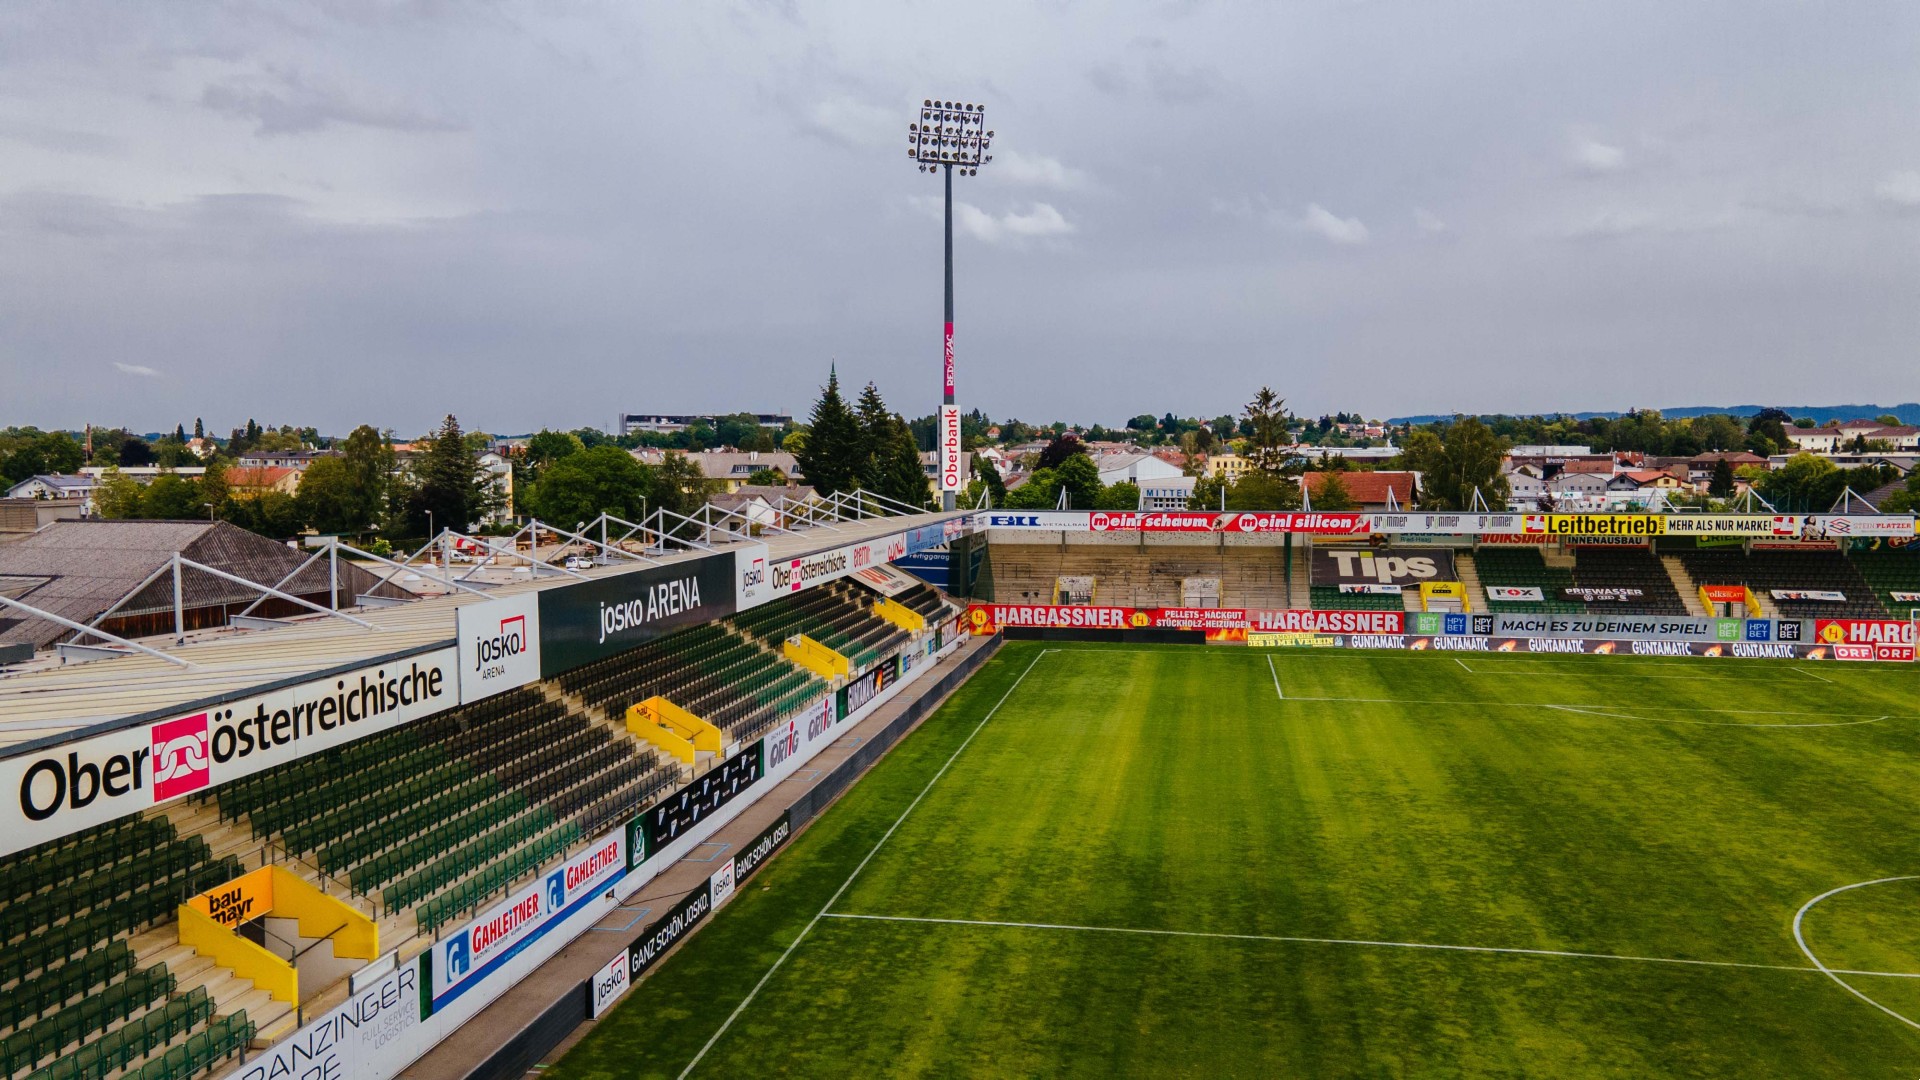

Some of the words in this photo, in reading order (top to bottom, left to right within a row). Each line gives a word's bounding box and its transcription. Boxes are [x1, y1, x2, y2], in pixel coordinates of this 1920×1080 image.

[945, 409, 958, 487] Oberbank
[1145, 514, 1207, 527] schaum
[1240, 514, 1292, 529] meinl
[1295, 514, 1351, 528] silicon
[1548, 515, 1657, 534] Leitbetrieb
[1669, 520, 1693, 530] MEHR
[1696, 520, 1713, 530] ALS
[1715, 520, 1734, 531] NUR
[1736, 520, 1772, 531] MARKE!
[772, 566, 792, 589] Ober
[800, 552, 846, 581] österreichische
[1328, 551, 1438, 583] Tips
[743, 569, 762, 592] josko
[1565, 588, 1643, 596] PRIEWASSER
[600, 599, 642, 644] josko
[646, 576, 701, 622] ARENA
[994, 607, 1124, 626] HARGASSNER
[1165, 610, 1199, 619] PELLETS
[1204, 611, 1242, 620] HACKGUT
[1156, 618, 1251, 629] STÜCKHOLZ-HEIZUNGEN
[1259, 612, 1399, 632] HARGASSNER
[1420, 624, 1437, 632] BET
[1447, 624, 1464, 632] BET
[1474, 624, 1491, 632] BET
[1501, 621, 1546, 631] MACH
[1550, 621, 1568, 632] ES
[1572, 622, 1592, 632] ZU
[1595, 622, 1655, 634] DEINEM
[1659, 623, 1707, 635] SPIEL!
[1719, 622, 1737, 630] HPY
[1749, 623, 1768, 631] HPY
[1719, 630, 1737, 638] BET
[1749, 631, 1768, 639] BET
[1780, 631, 1799, 639] BET
[1352, 635, 1405, 649] GUNTAMATIC
[1434, 637, 1489, 650] GUNTAMATIC
[1528, 639, 1585, 653] GUNTAMATIC
[1631, 641, 1692, 655] GUNTAMATIC
[475, 633, 520, 672] josko
[1732, 643, 1794, 658] GUNTAMATIC
[1838, 648, 1870, 658] ORF
[1879, 649, 1911, 658] ORF
[482, 665, 505, 680] ARENA
[20, 747, 150, 821] Ober
[211, 662, 443, 764] österreichische
[736, 858, 752, 878] GANZ
[752, 836, 771, 860] SCHÖN
[713, 872, 730, 902] josko
[209, 887, 242, 914] bau
[210, 896, 254, 925] mayr
[632, 940, 655, 973] GANZ
[656, 915, 683, 950] SCHÖN
[684, 892, 709, 926] JOSKO.
[597, 969, 623, 1006] josko
[361, 1028, 383, 1046] FULL
[384, 1000, 416, 1029] SERVICE
[374, 1012, 416, 1050] LOGISTICS
